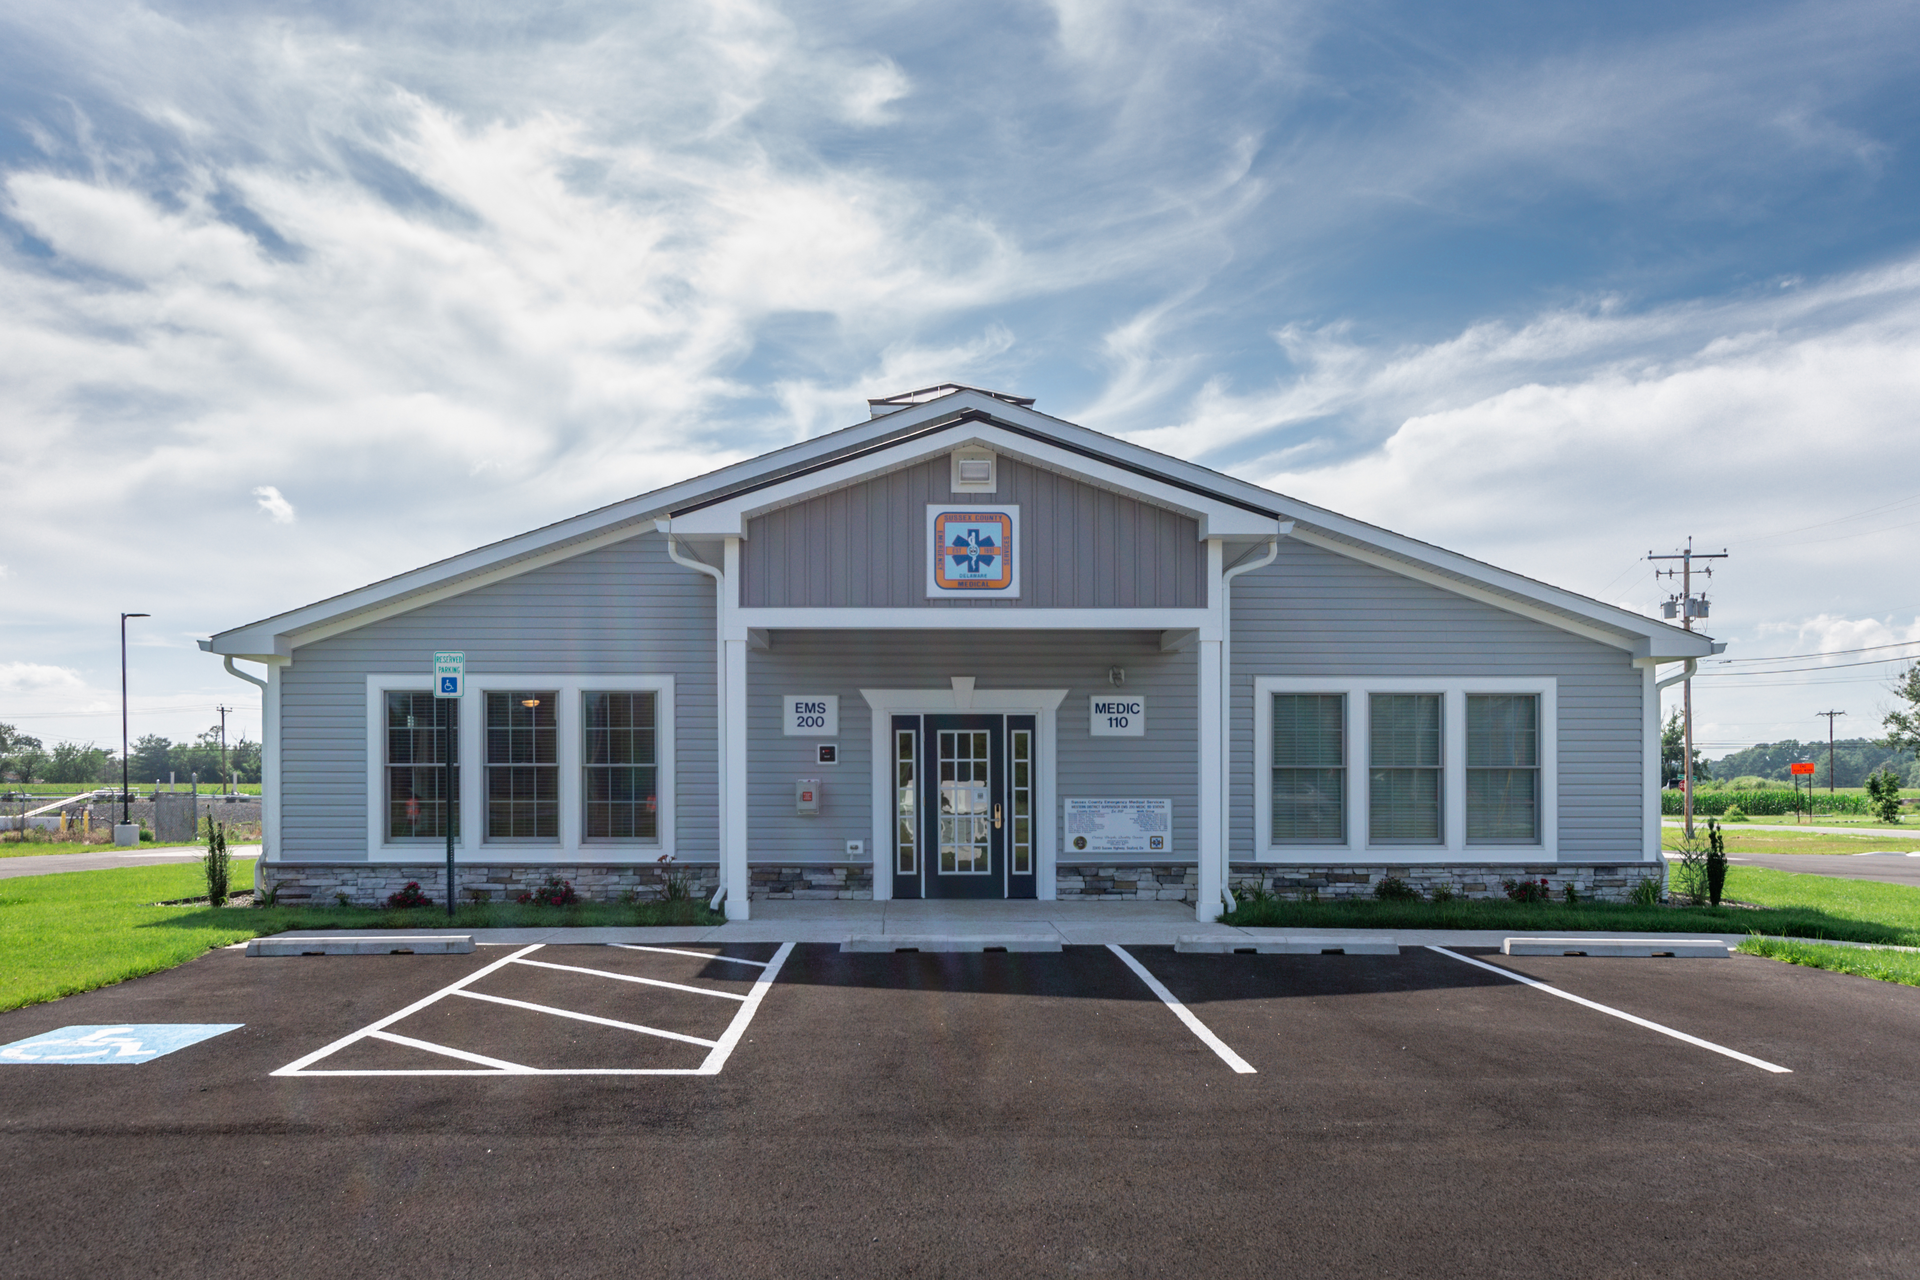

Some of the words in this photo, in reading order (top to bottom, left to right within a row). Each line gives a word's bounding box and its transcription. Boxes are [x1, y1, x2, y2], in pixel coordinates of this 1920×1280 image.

[438, 666, 460, 674] PARKING
[795, 702, 826, 714] EMS
[1095, 703, 1140, 714] MEDIC
[797, 716, 825, 728] 200
[1107, 716, 1128, 728] 110
